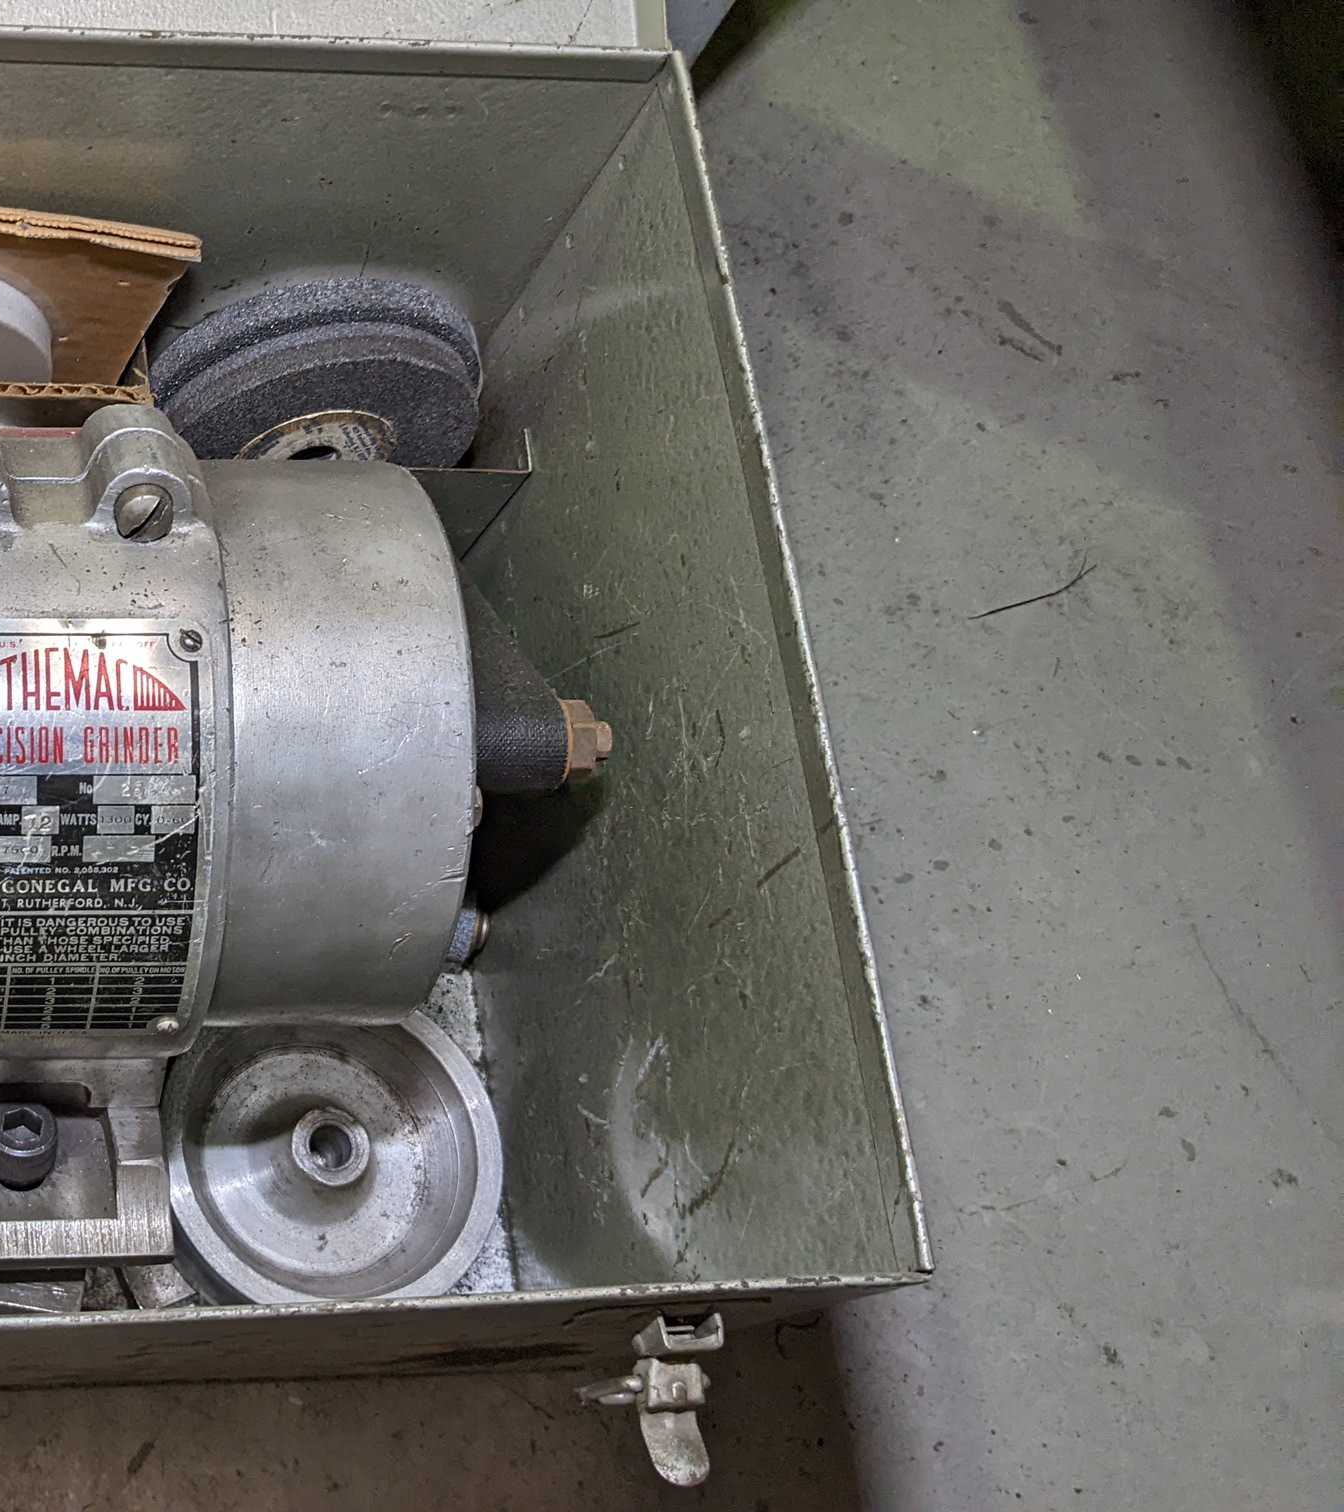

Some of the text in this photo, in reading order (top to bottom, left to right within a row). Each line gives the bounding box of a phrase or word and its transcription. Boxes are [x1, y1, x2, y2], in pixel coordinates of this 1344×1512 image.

[0, 647, 129, 711] THEMAC
[83, 726, 178, 765] GRINDER
[60, 814, 96, 826] WATTS
[4, 867, 51, 875] PATENTED
[109, 878, 156, 892] MFG.
[163, 878, 193, 891] CO.
[1, 918, 16, 927] IT
[18, 918, 32, 927] IS
[36, 918, 129, 927] DANGEROUS
[132, 918, 152, 926] TO
[155, 917, 185, 926] USE
[0, 926, 183, 936] PULLEY COMBINATIONS
[40, 936, 89, 945] THOSE
[3, 945, 33, 954] USE
[39, 945, 48, 953] A
[54, 945, 105, 953] WHEEL
[111, 944, 169, 953] LARGER
[0, 954, 36, 962] INCH
[35, 966, 63, 974] PULLEY
